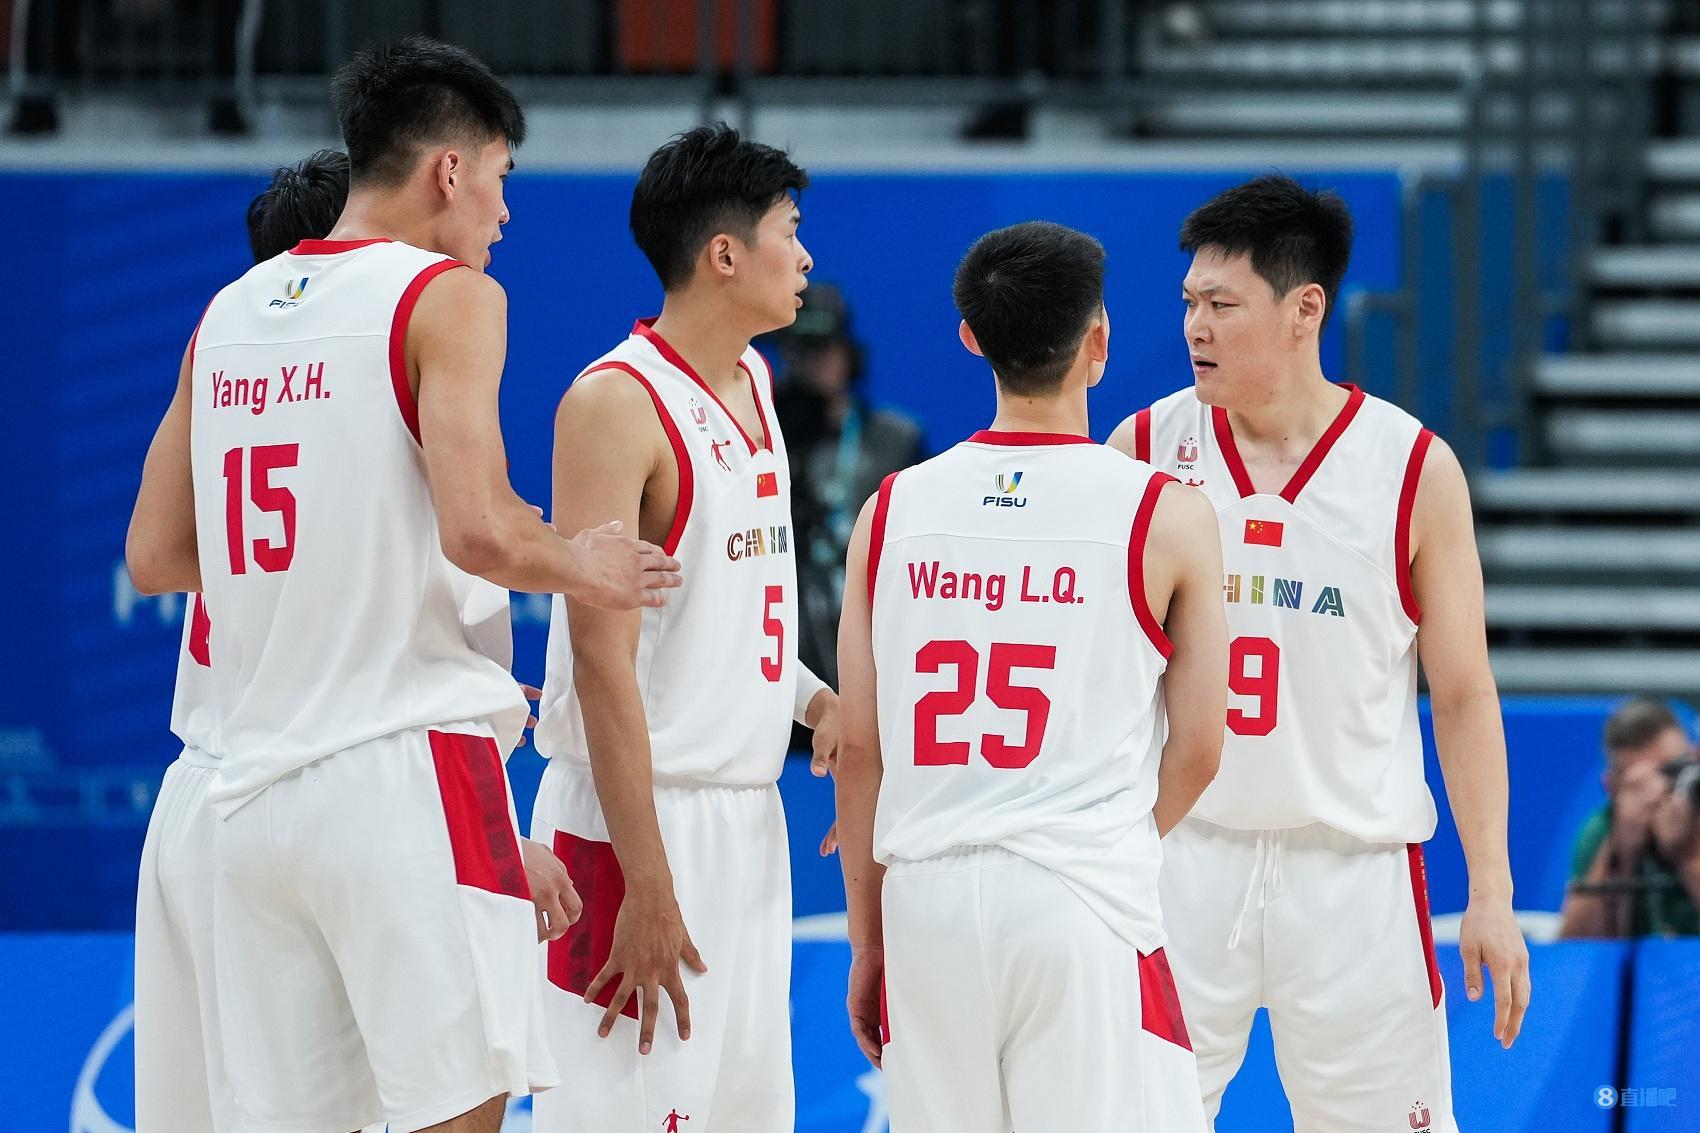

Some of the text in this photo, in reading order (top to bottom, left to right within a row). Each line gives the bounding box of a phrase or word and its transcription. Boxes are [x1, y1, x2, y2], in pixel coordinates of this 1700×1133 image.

[212, 362, 331, 415] Yang X.H.
[223, 443, 299, 575] 15
[982, 495, 1027, 508] FISU
[726, 525, 788, 561] CHIN
[907, 560, 1084, 611] Wang L.Q.
[1223, 573, 1346, 618] HINA
[760, 585, 784, 683] 5
[913, 639, 1057, 769] 25
[1226, 636, 1281, 737] 9
